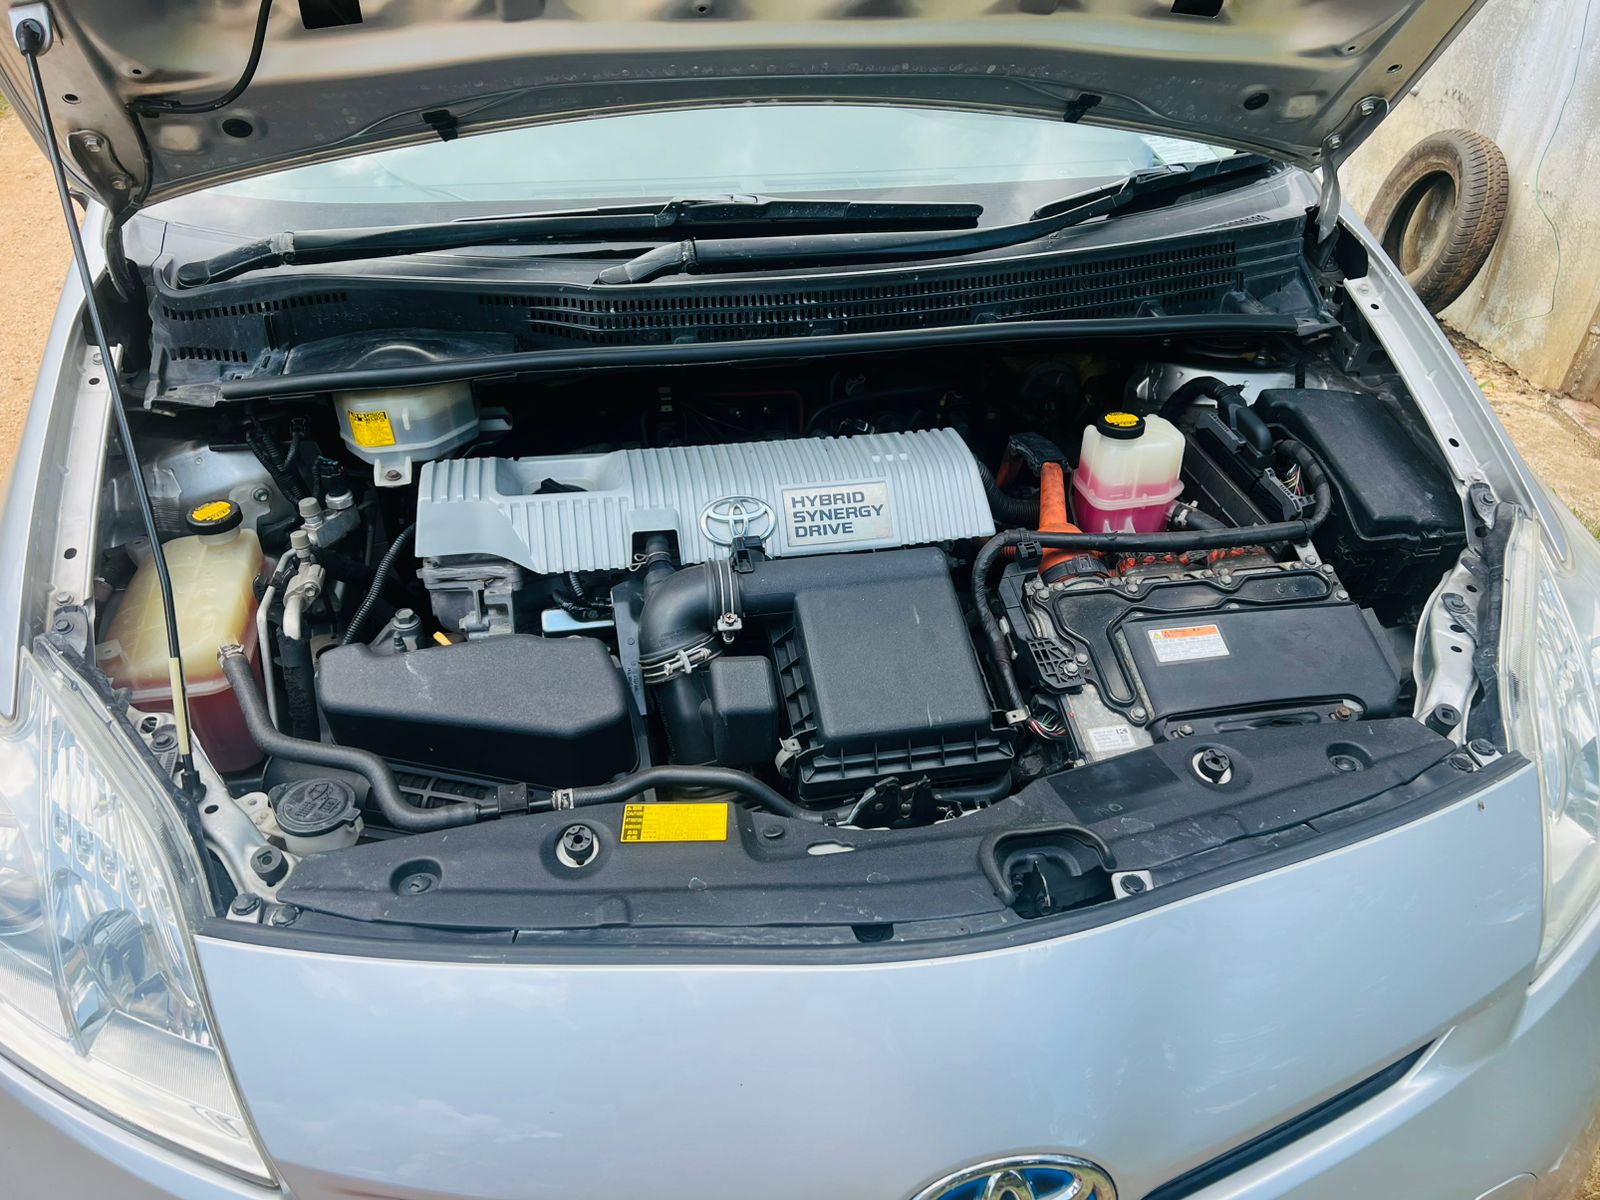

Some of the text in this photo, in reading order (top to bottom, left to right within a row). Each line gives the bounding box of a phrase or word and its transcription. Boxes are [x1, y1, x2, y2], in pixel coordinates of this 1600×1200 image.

[791, 491, 865, 508] HYBRID
[793, 504, 884, 523] SYNERGY
[795, 522, 854, 538] DRIVE
